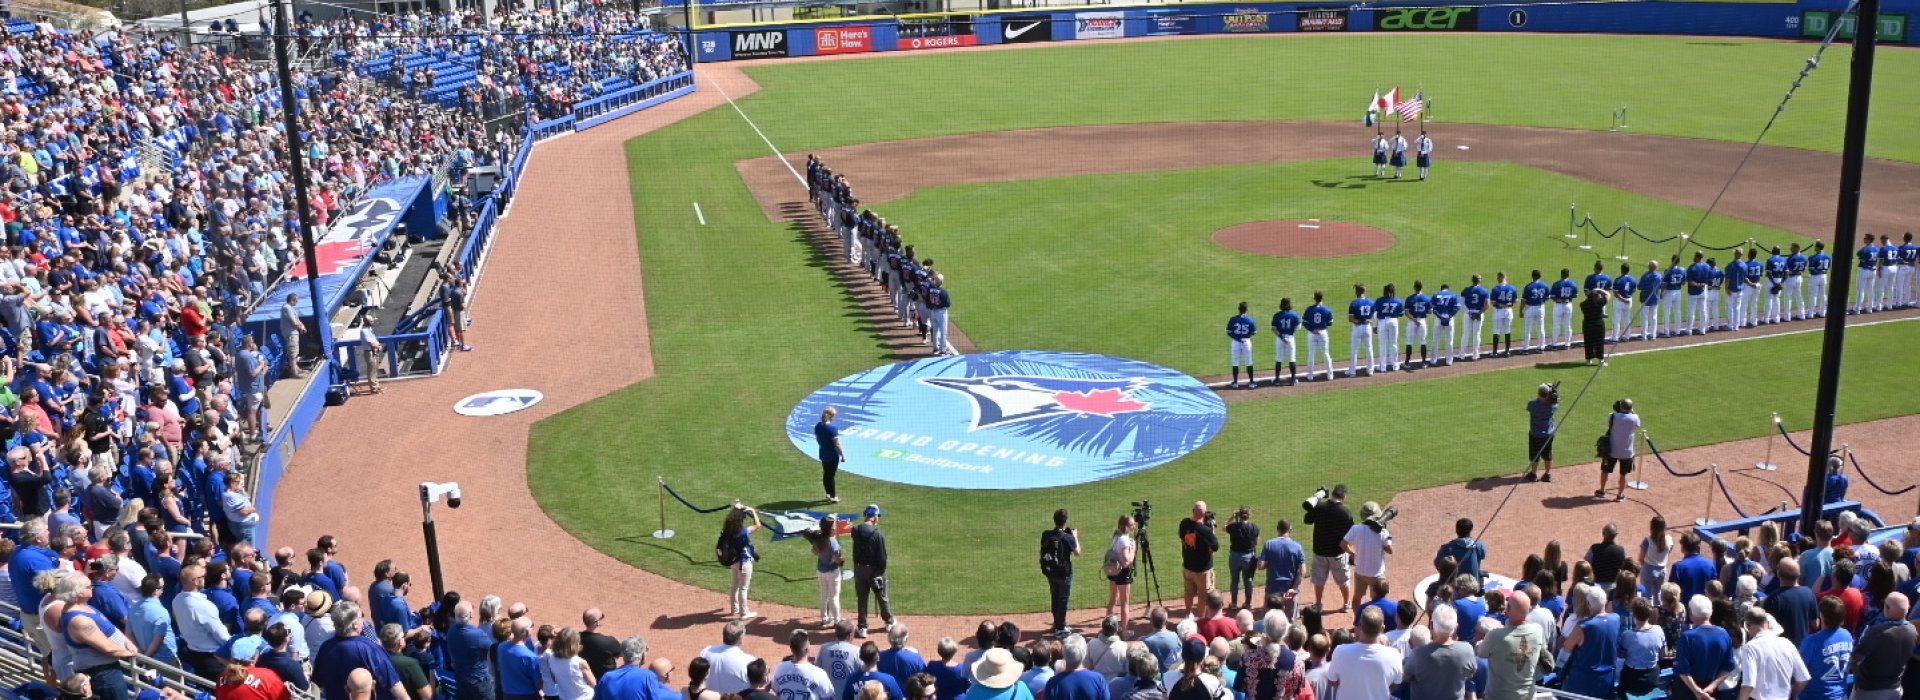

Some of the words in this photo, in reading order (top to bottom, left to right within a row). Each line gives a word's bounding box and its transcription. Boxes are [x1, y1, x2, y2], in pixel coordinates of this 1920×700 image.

[1380, 7, 1471, 29] acer
[1514, 13, 1521, 24] 1
[1807, 17, 1825, 32] TD
[1881, 19, 1903, 36] TD
[735, 31, 783, 51] MNP
[840, 31, 868, 41] Here's
[1472, 293, 1479, 304] 3
[1498, 290, 1512, 302] 46
[1360, 305, 1371, 316] 13
[1382, 302, 1397, 314] 27
[1414, 301, 1425, 312] 15
[1280, 318, 1291, 330] 11
[1313, 312, 1321, 324] 8
[1233, 322, 1249, 335] 25
[844, 426, 933, 447] GRAND
[938, 440, 1067, 467] OPENING
[905, 453, 993, 474] Ballpark
[832, 661, 846, 680] 8
